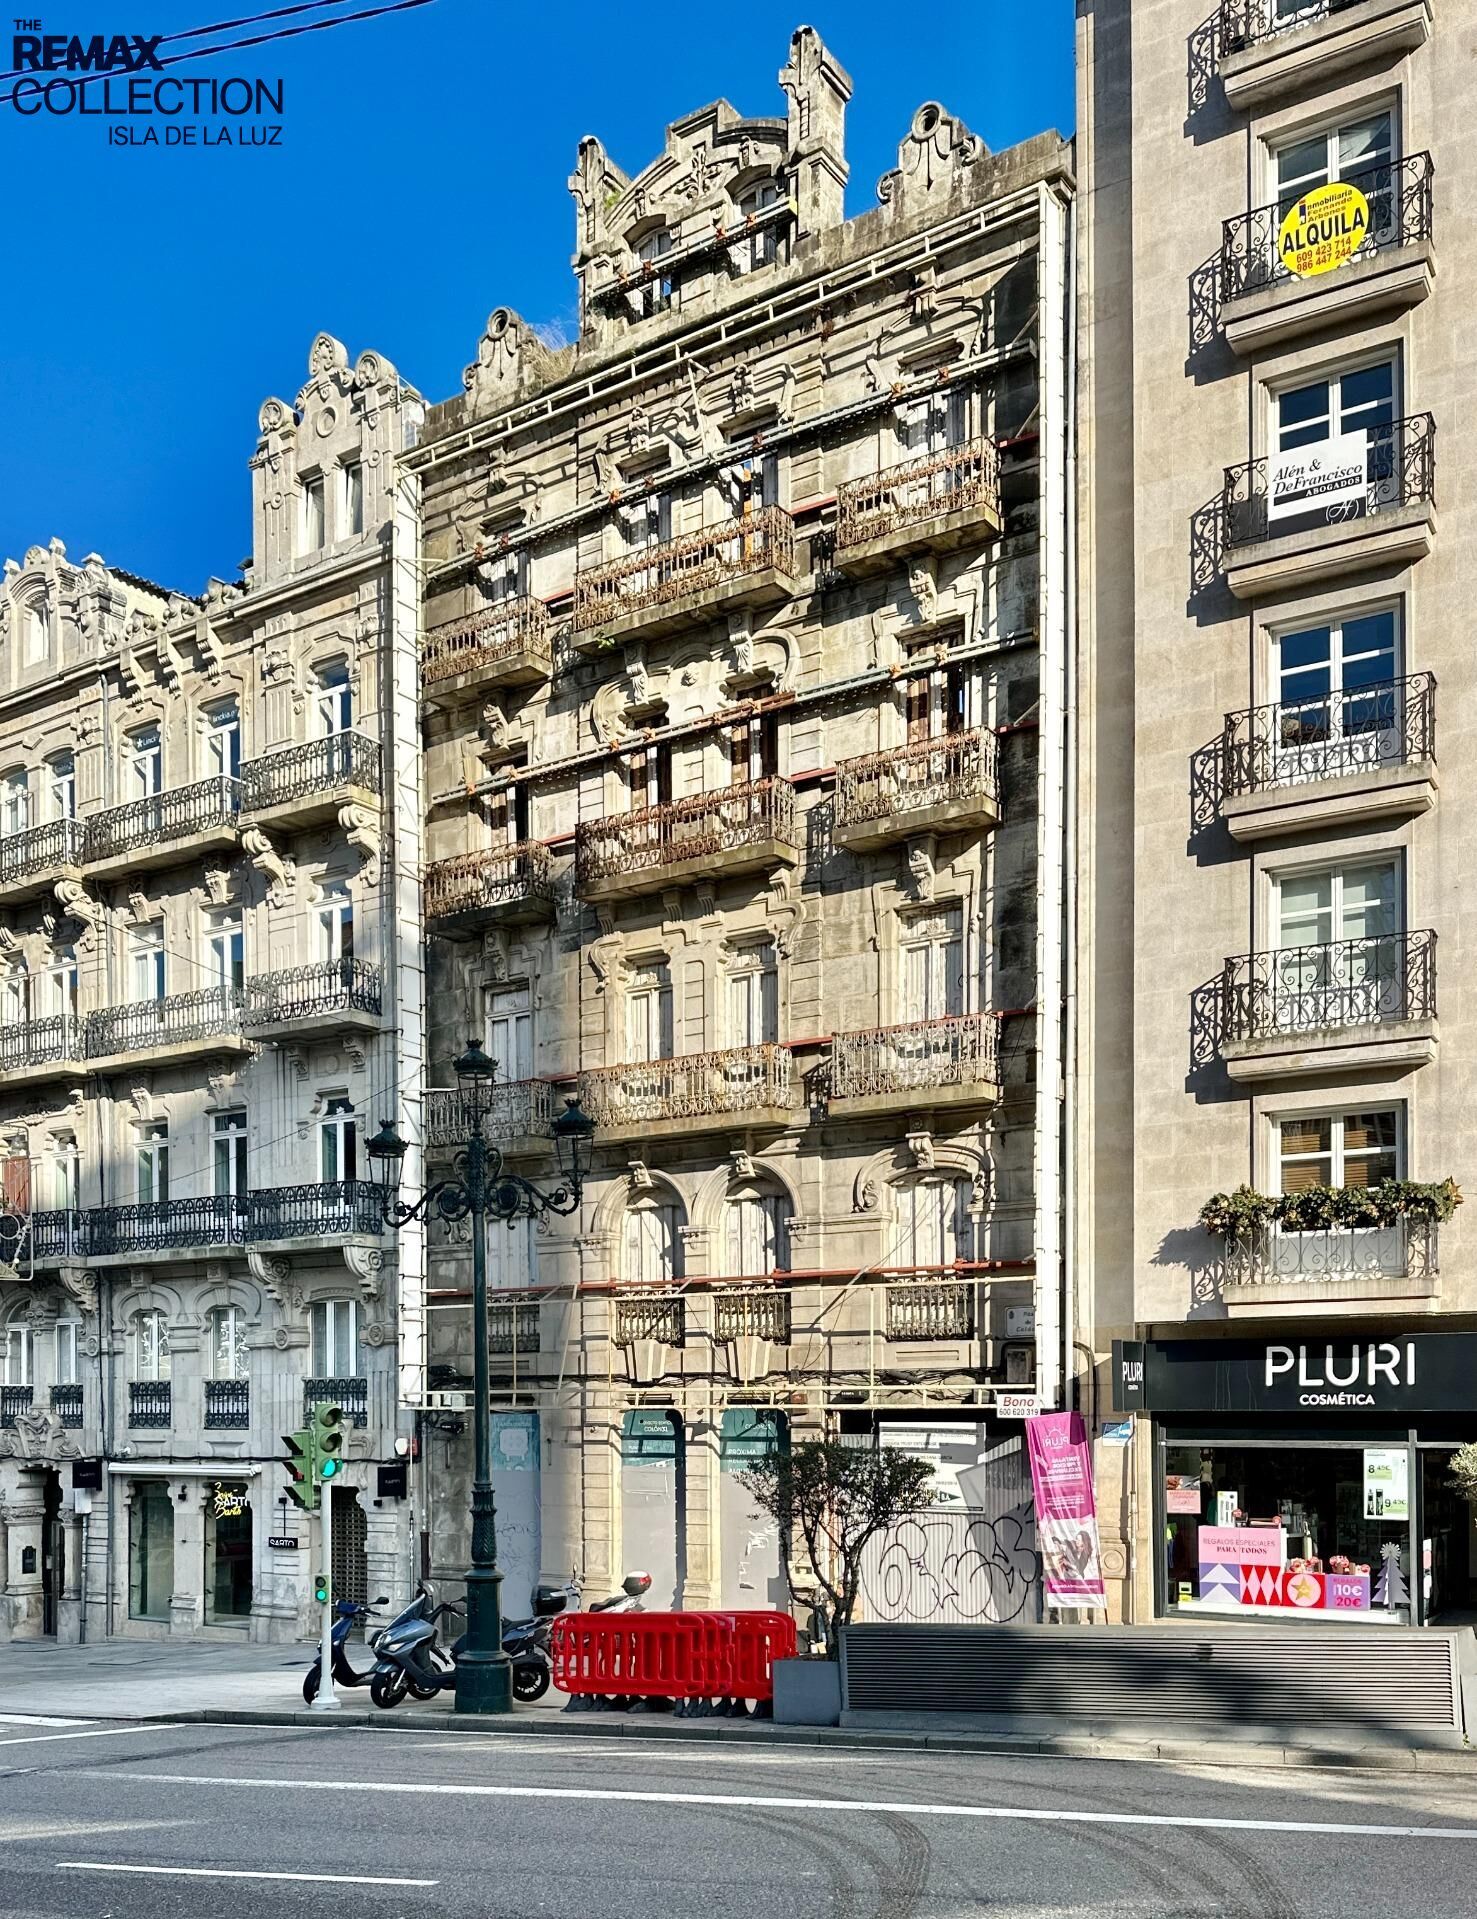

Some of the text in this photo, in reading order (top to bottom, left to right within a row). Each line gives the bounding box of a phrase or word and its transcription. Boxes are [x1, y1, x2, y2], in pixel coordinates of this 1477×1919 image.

[1283, 207, 1365, 255] ALQUILA
[1296, 236, 1352, 263] 609 423 714
[1296, 247, 1352, 273] 986 447 244
[1273, 458, 1322, 482] Alén &
[1273, 464, 1363, 496] DeFrancisco
[1305, 476, 1361, 497] ABOGADOS
[1122, 1361, 1143, 1382] PLURI
[1265, 1342, 1415, 1387] PLURI
[1003, 1396, 1035, 1407] Bono
[1299, 1391, 1376, 1406] COSMÉTICA
[1026, 1408, 1039, 1416] 319
[269, 1538, 295, 1547] SARTO
[1203, 1537, 1276, 1547] REGALOS ESPECIALES
[1336, 1597, 1363, 1608] 20€
